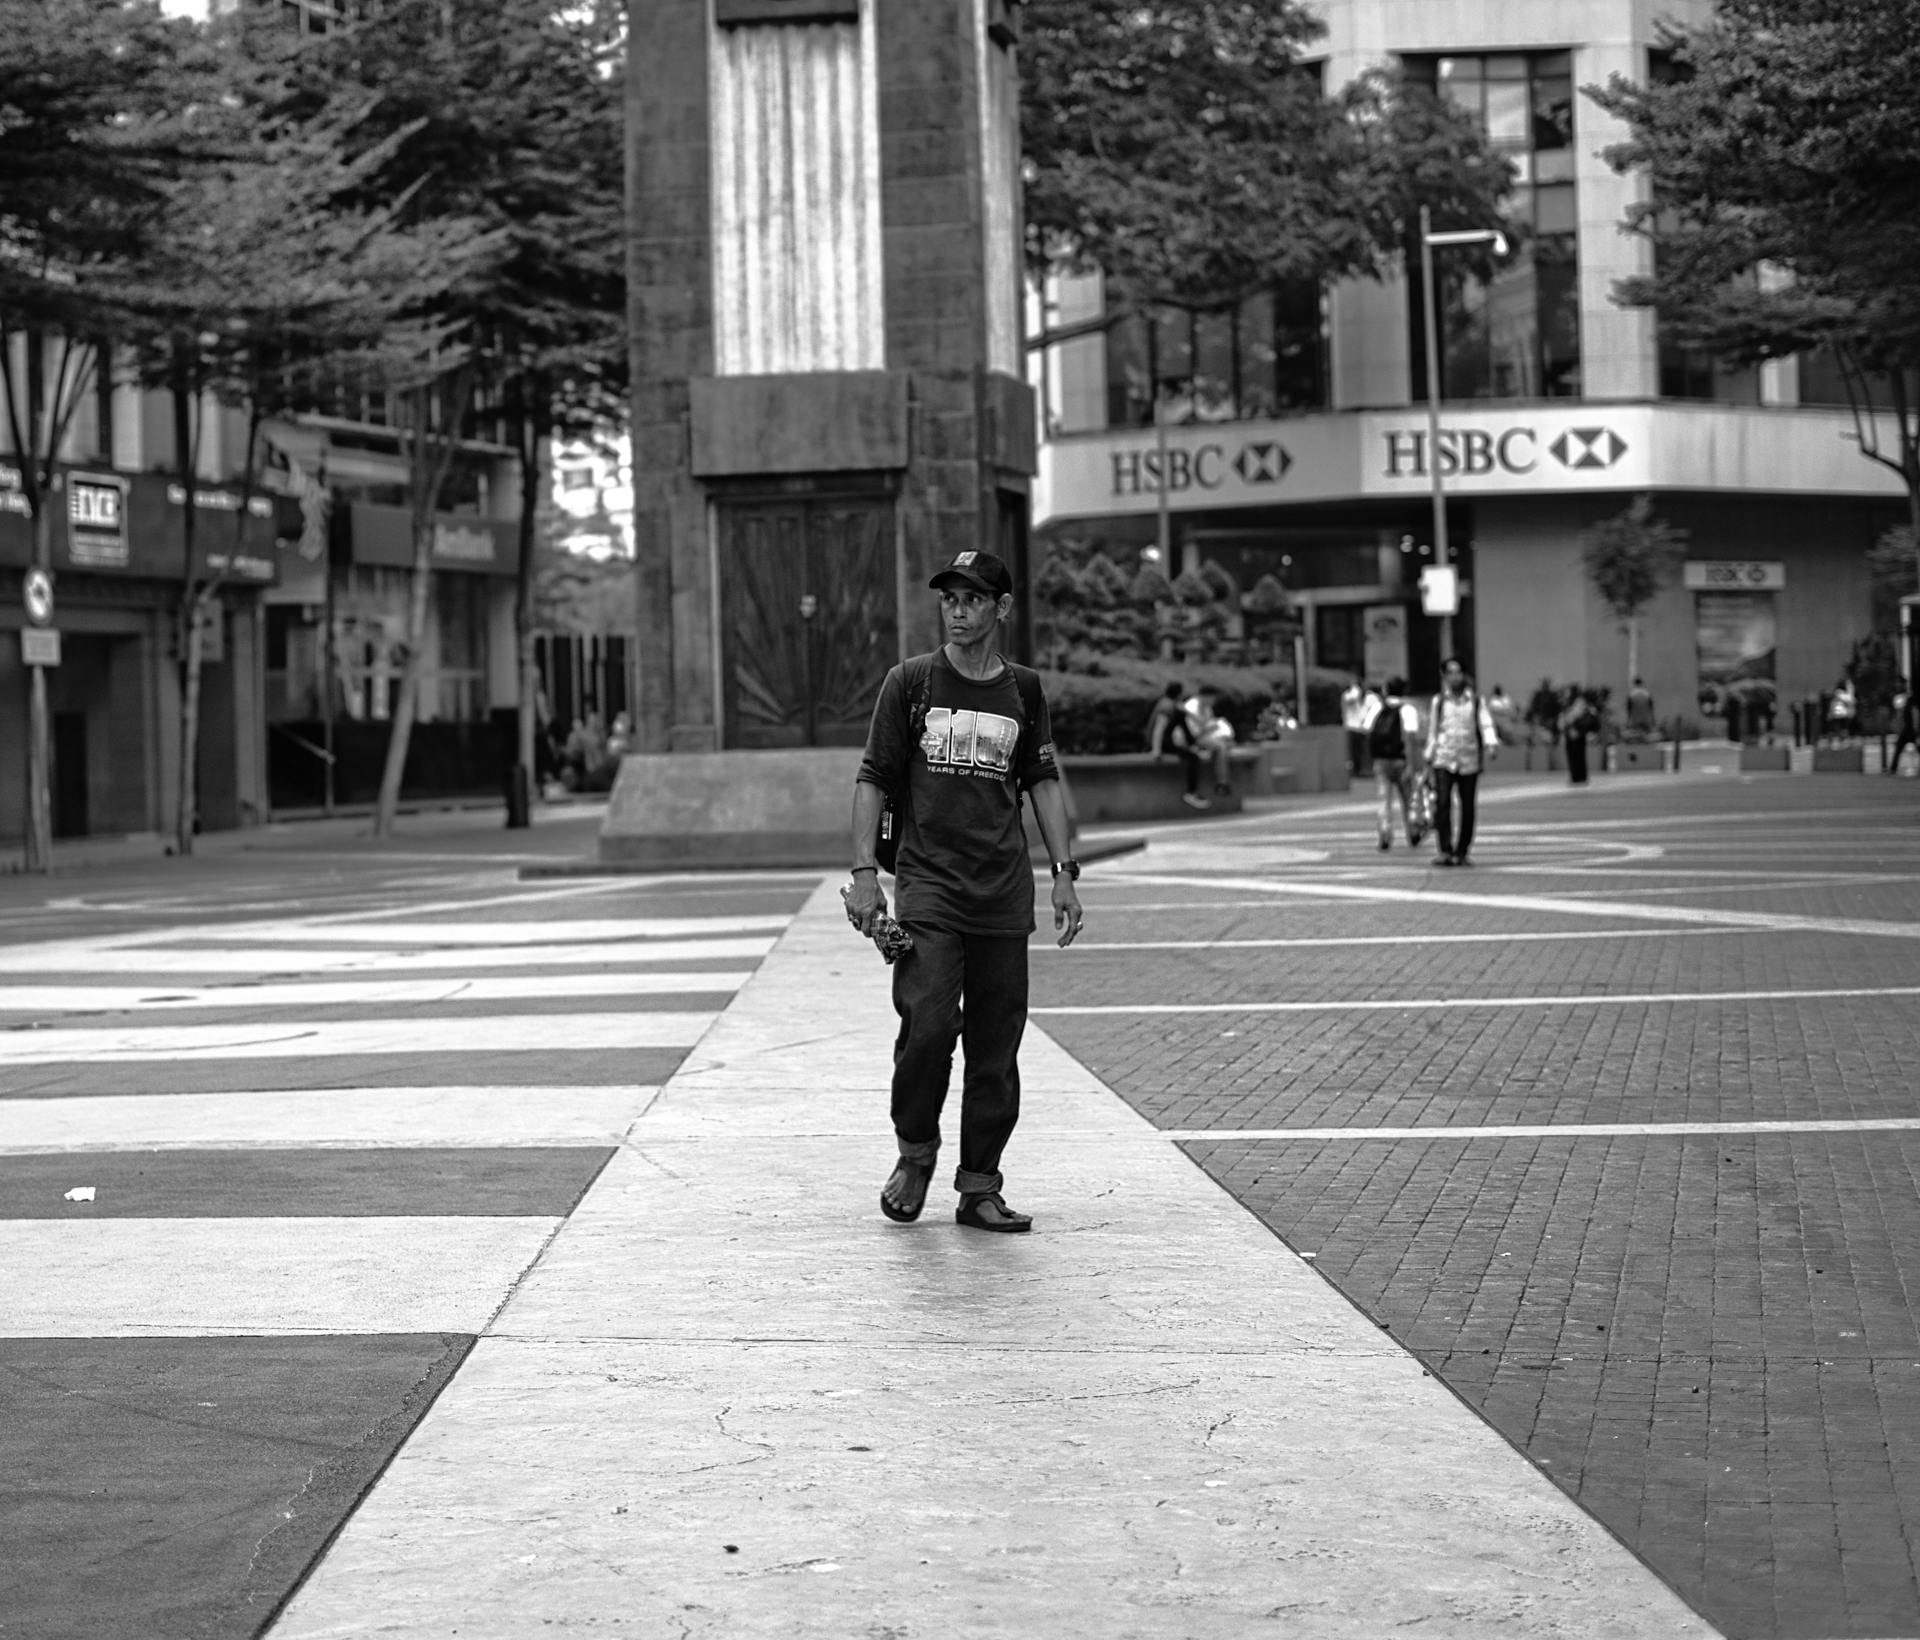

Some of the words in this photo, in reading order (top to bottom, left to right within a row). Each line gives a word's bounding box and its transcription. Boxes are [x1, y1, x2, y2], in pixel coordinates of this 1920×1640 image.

[1110, 443, 1225, 497] HSBC
[1382, 426, 1538, 478] HSBC
[925, 707, 1019, 772] 110
[927, 765, 955, 774] YEARS
[958, 768, 971, 776] OF
[973, 770, 1007, 781] FREEDO
